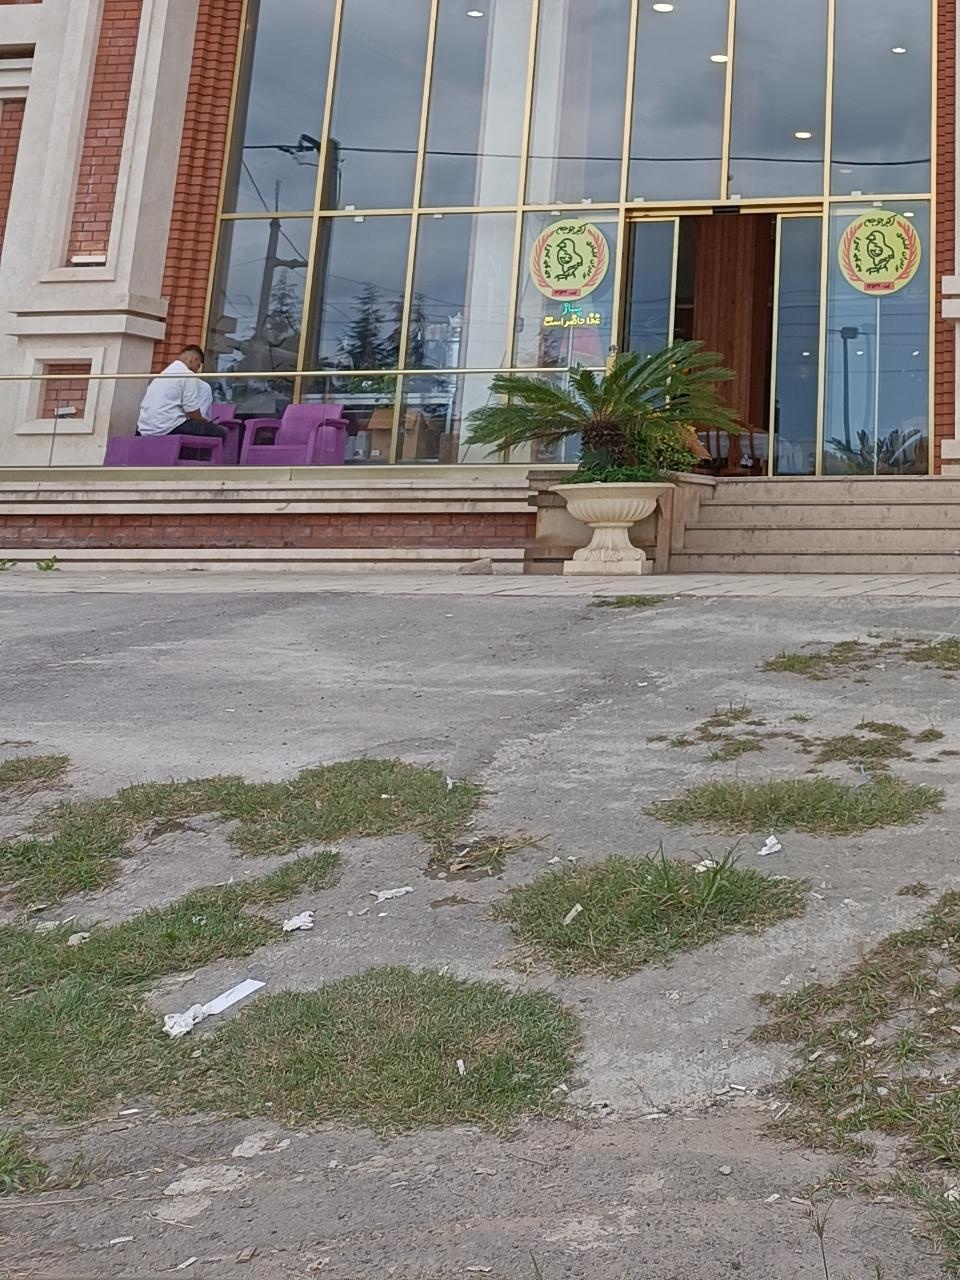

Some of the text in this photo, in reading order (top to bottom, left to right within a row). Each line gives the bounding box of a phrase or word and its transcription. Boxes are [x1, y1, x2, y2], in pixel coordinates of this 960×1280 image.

[544, 312, 600, 327] غذا حاضر است
